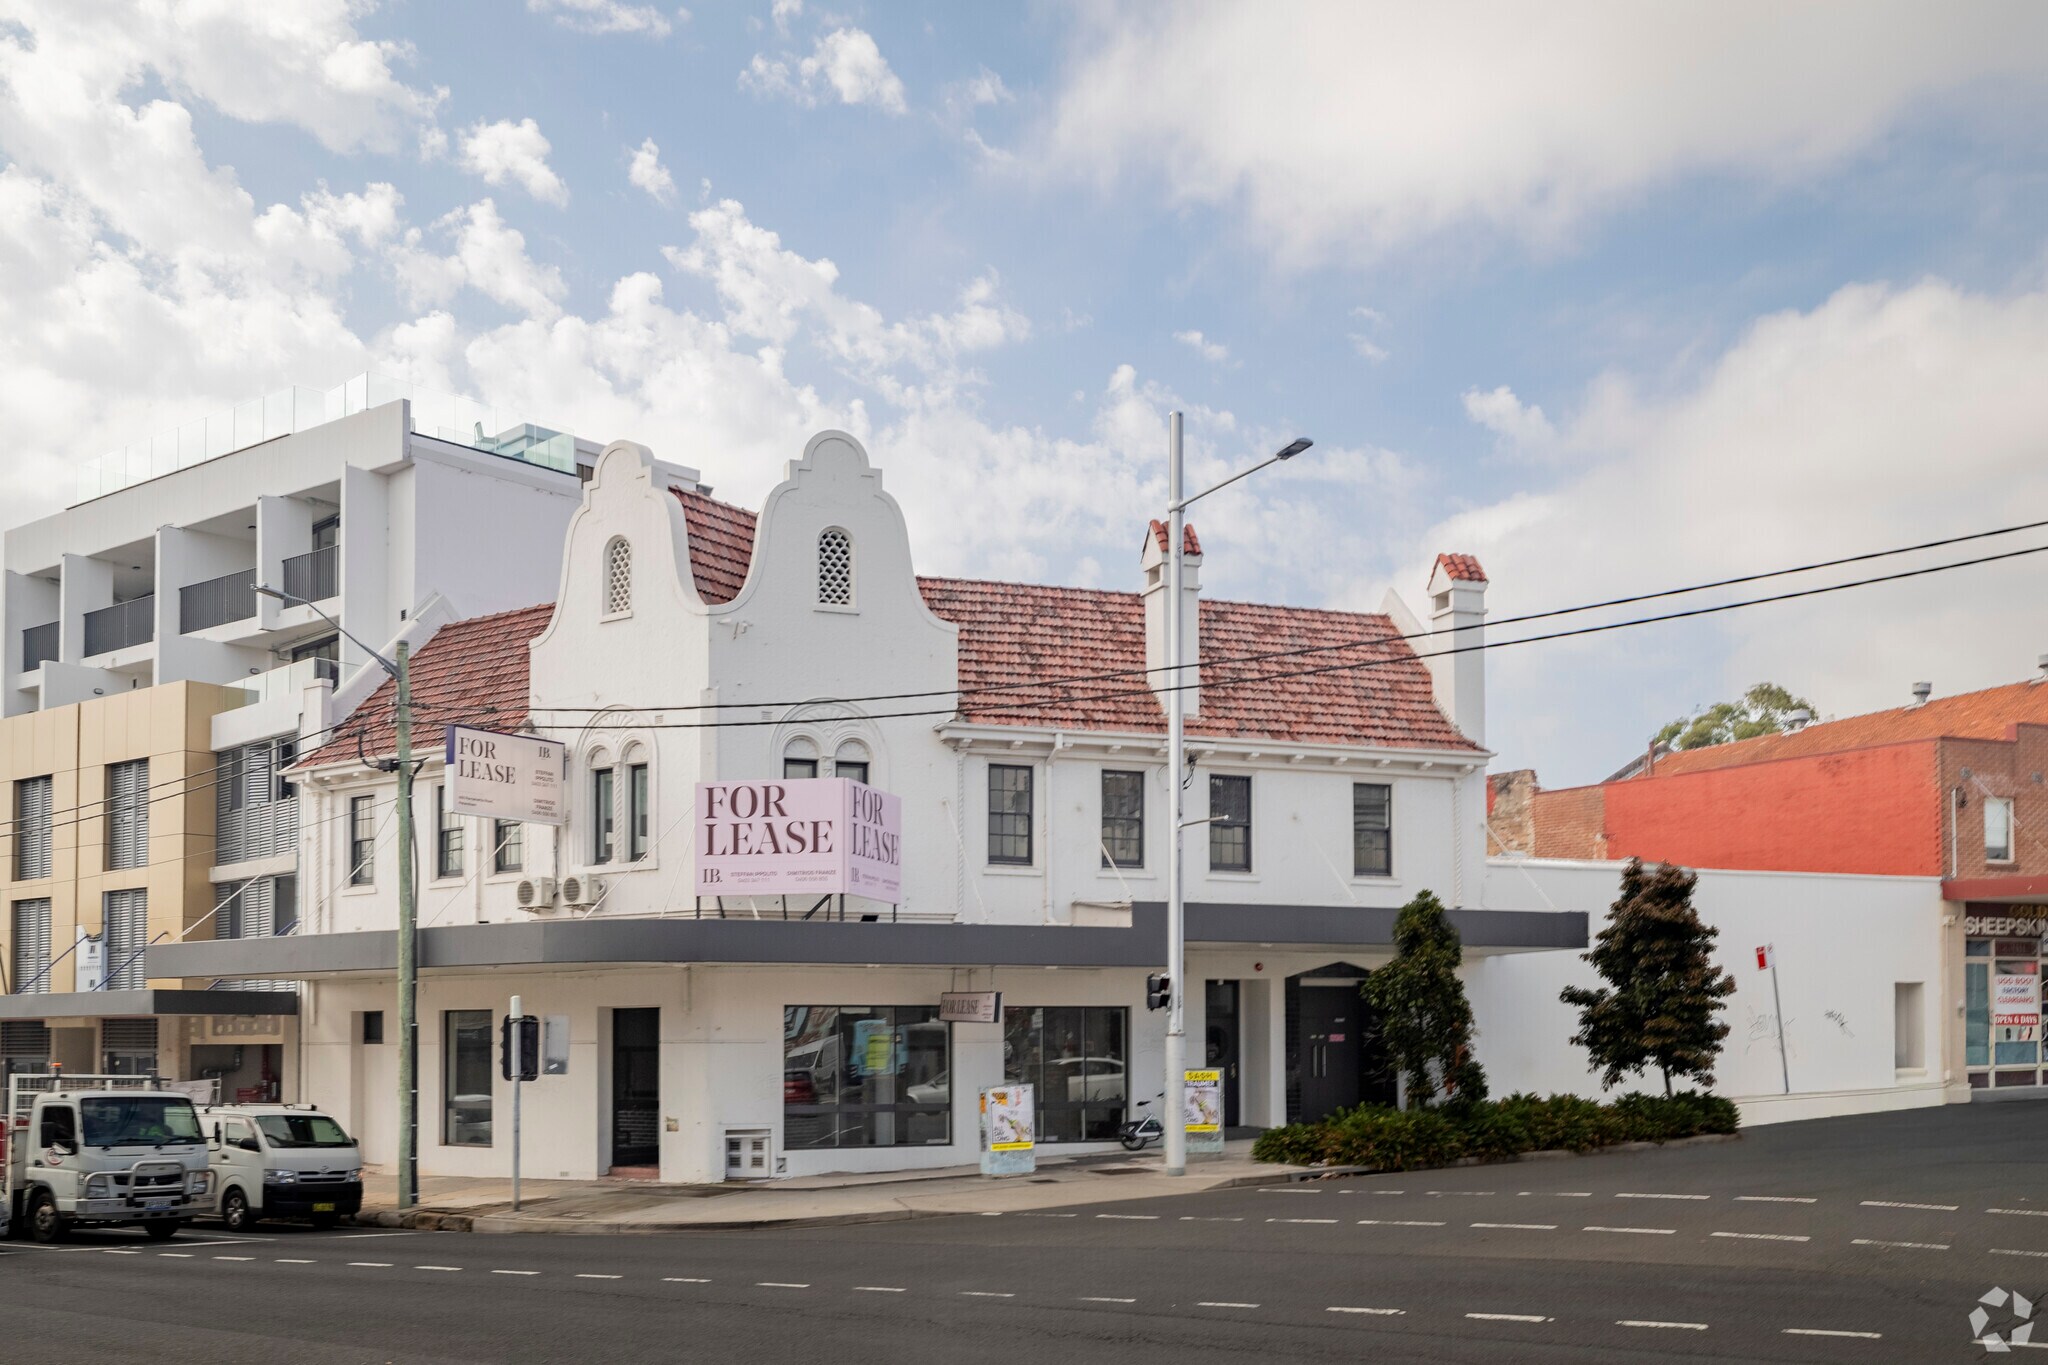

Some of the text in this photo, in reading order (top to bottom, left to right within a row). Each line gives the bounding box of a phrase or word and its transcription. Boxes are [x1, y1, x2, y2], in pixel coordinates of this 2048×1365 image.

[459, 737, 496, 760] FOR
[459, 759, 516, 785] LEASE
[704, 785, 788, 819] FOR
[852, 785, 883, 826] FOR
[704, 820, 833, 856] LEASE
[852, 822, 899, 866] LEASE
[956, 999, 980, 1015] LEASE
[1995, 1014, 2013, 1024] OPEN
[2020, 1014, 2038, 1024] DAYS
